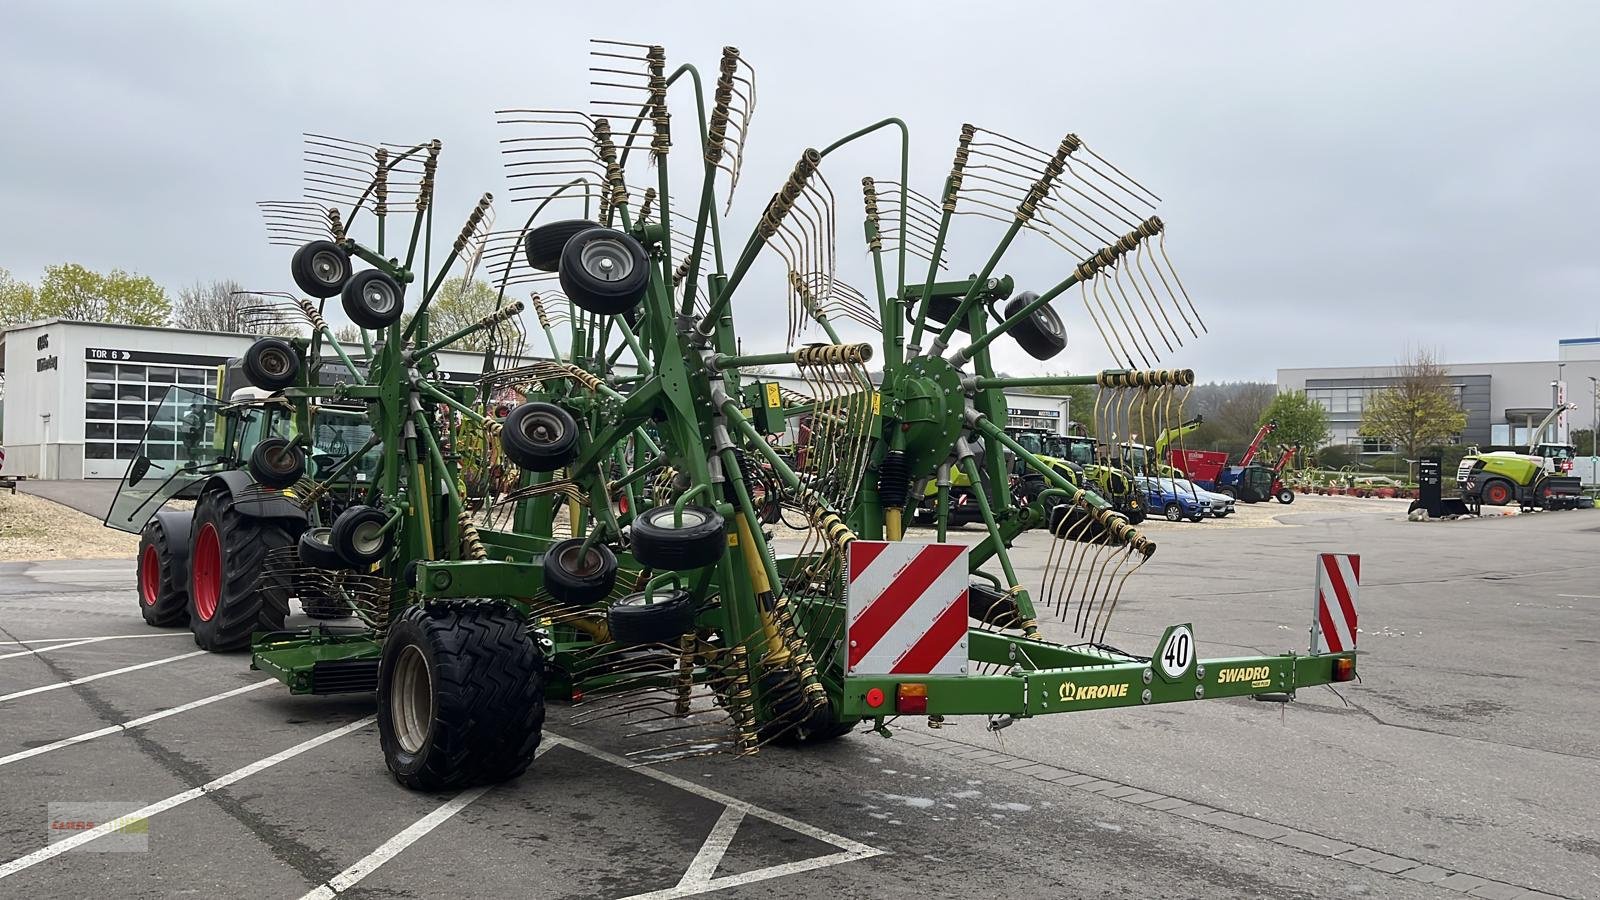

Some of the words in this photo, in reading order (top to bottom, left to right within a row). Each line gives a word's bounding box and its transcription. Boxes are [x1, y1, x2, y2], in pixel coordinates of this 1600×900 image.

[91, 349, 107, 359] TOR
[111, 350, 118, 360] 6
[1165, 634, 1188, 667] 40
[1217, 666, 1270, 684] SWADRO
[1076, 684, 1129, 700] KRONE
